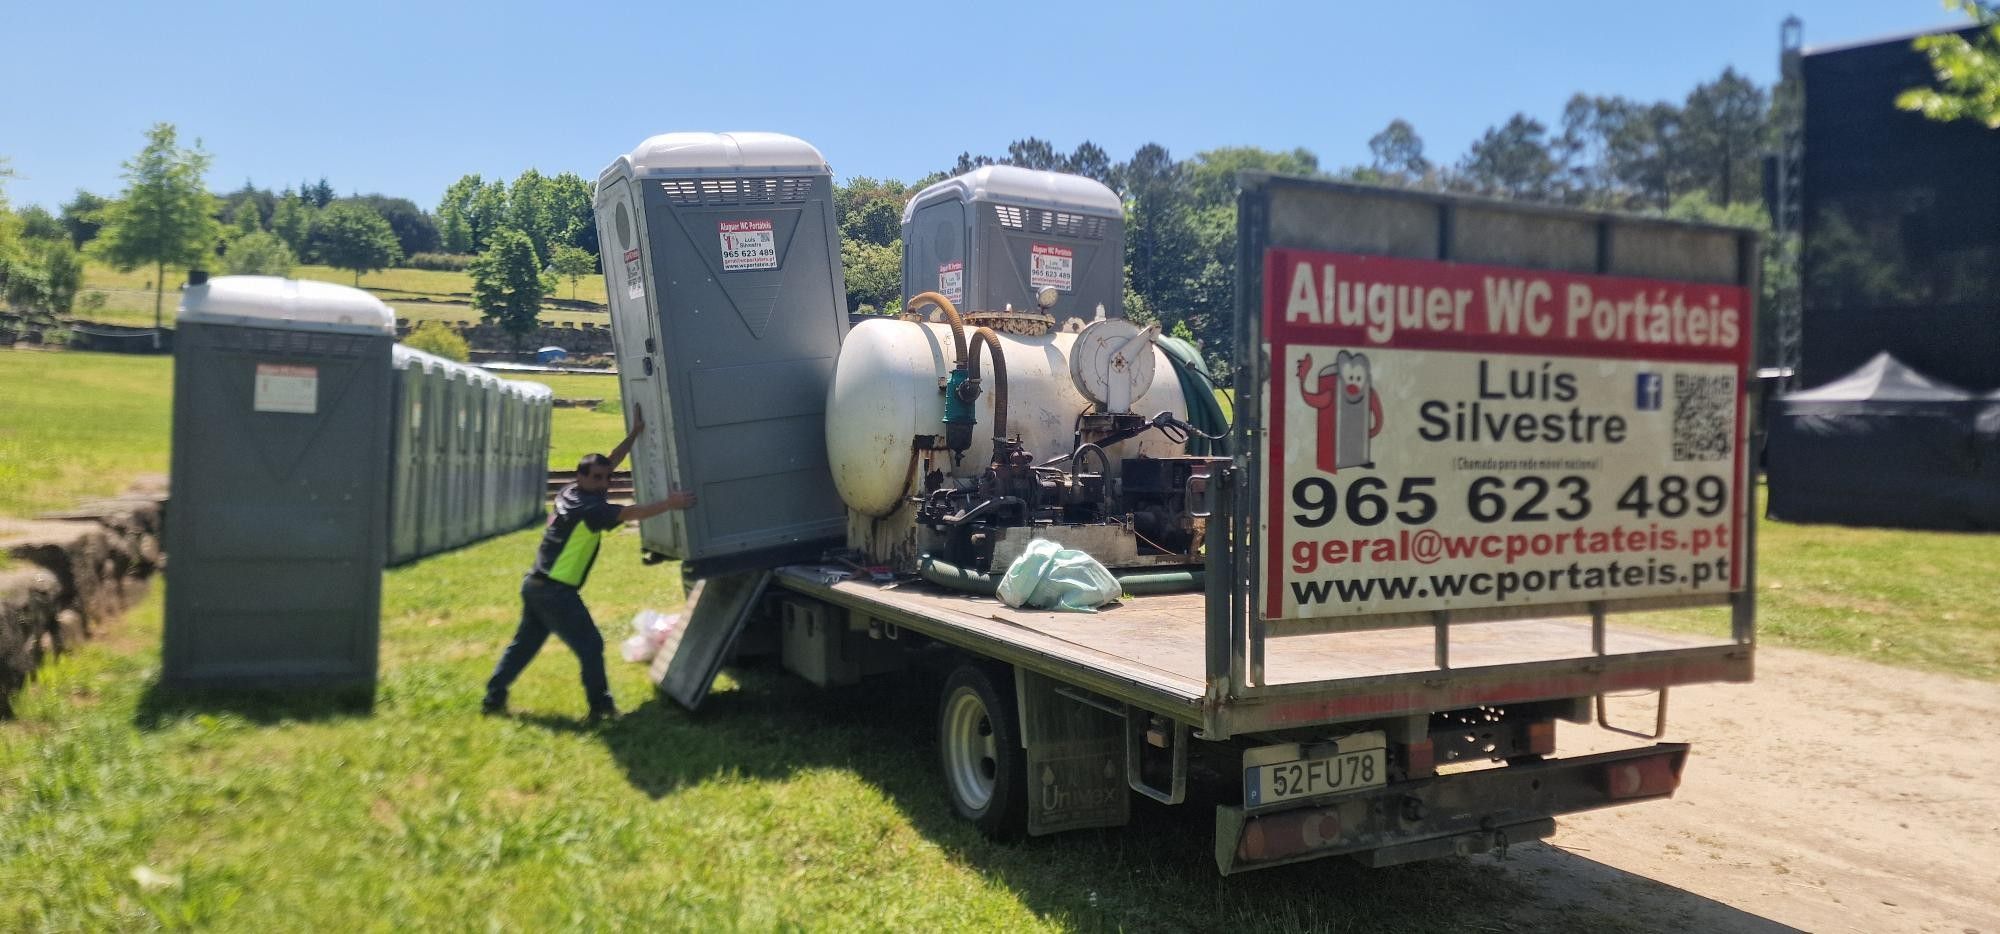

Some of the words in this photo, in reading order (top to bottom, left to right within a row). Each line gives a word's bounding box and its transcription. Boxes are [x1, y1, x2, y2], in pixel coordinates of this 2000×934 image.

[723, 250, 739, 258] 965
[1286, 261, 1474, 344] Aluguer
[1484, 275, 1552, 337] WC
[1566, 282, 1740, 347] Portáteis
[1479, 359, 1578, 402] Luís
[1418, 400, 1627, 443] Silvestre
[1292, 476, 1438, 528] 965
[1468, 475, 1592, 522] 623
[1616, 475, 1728, 519] 489
[1291, 523, 1730, 574] geral@wcportateis.pt
[1290, 555, 1730, 605] www.wcportateis.pt
